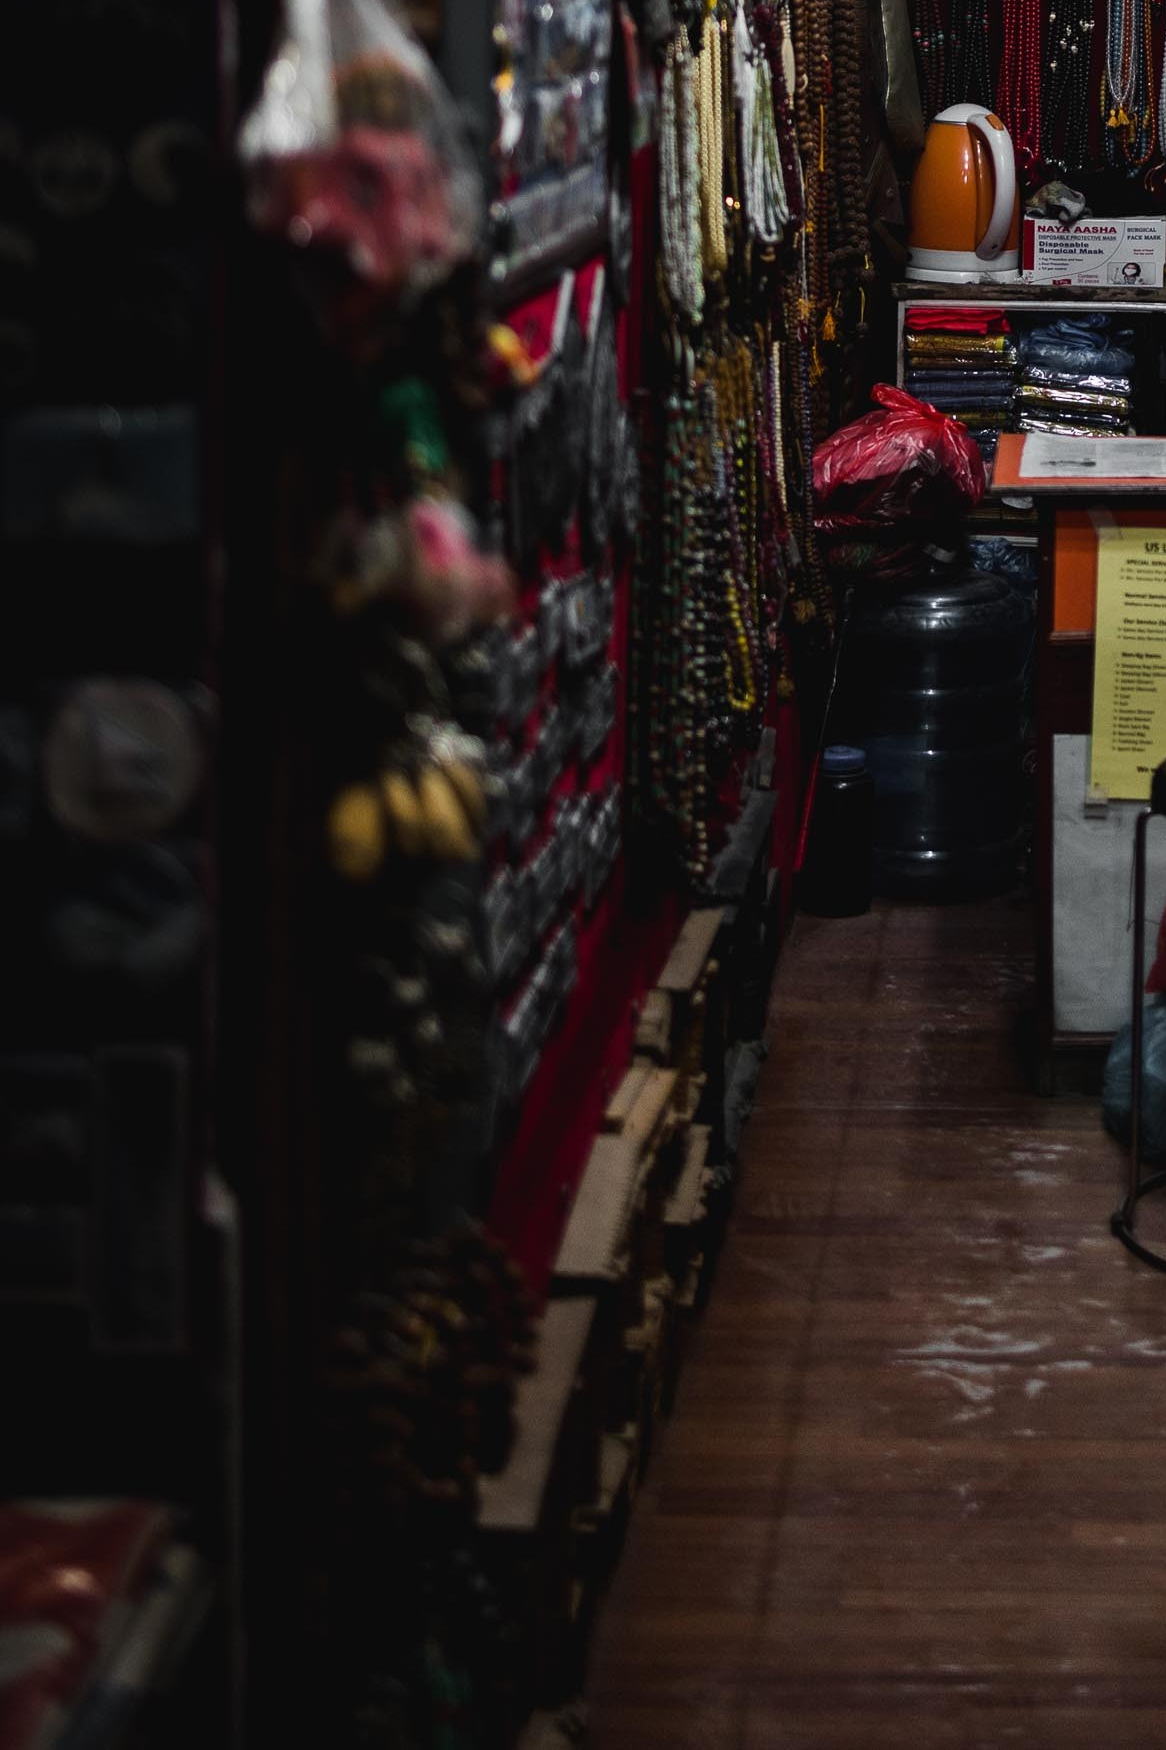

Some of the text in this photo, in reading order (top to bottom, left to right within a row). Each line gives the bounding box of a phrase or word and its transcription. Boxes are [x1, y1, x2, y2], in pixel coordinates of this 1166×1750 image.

[1037, 225, 1117, 234] NAYA AASHA
[1145, 542, 1160, 552] US
